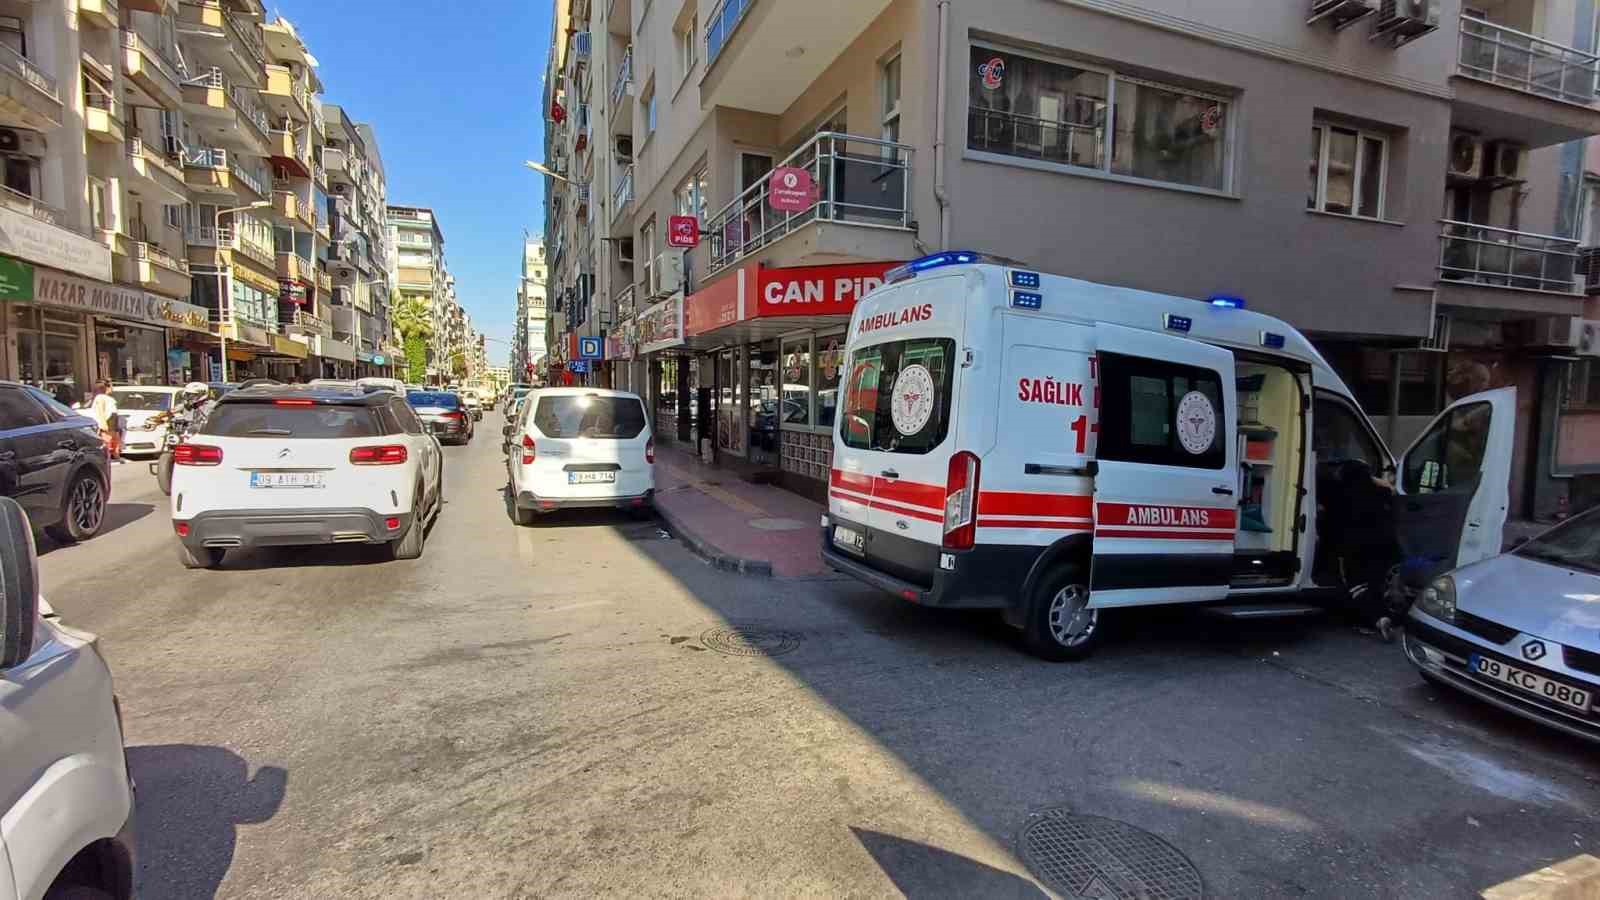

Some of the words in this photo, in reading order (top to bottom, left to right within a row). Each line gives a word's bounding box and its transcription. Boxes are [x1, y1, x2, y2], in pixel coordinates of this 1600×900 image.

[39, 277, 86, 306] NAZAR
[764, 279, 824, 304] CAN
[857, 303, 933, 334] AMBULANS
[1018, 376, 1083, 406] SAĞLIK
[1127, 507, 1209, 526] AMBULANS
[1478, 658, 1500, 676] 09
[1506, 668, 1537, 689] KC
[1543, 681, 1586, 707] 080
